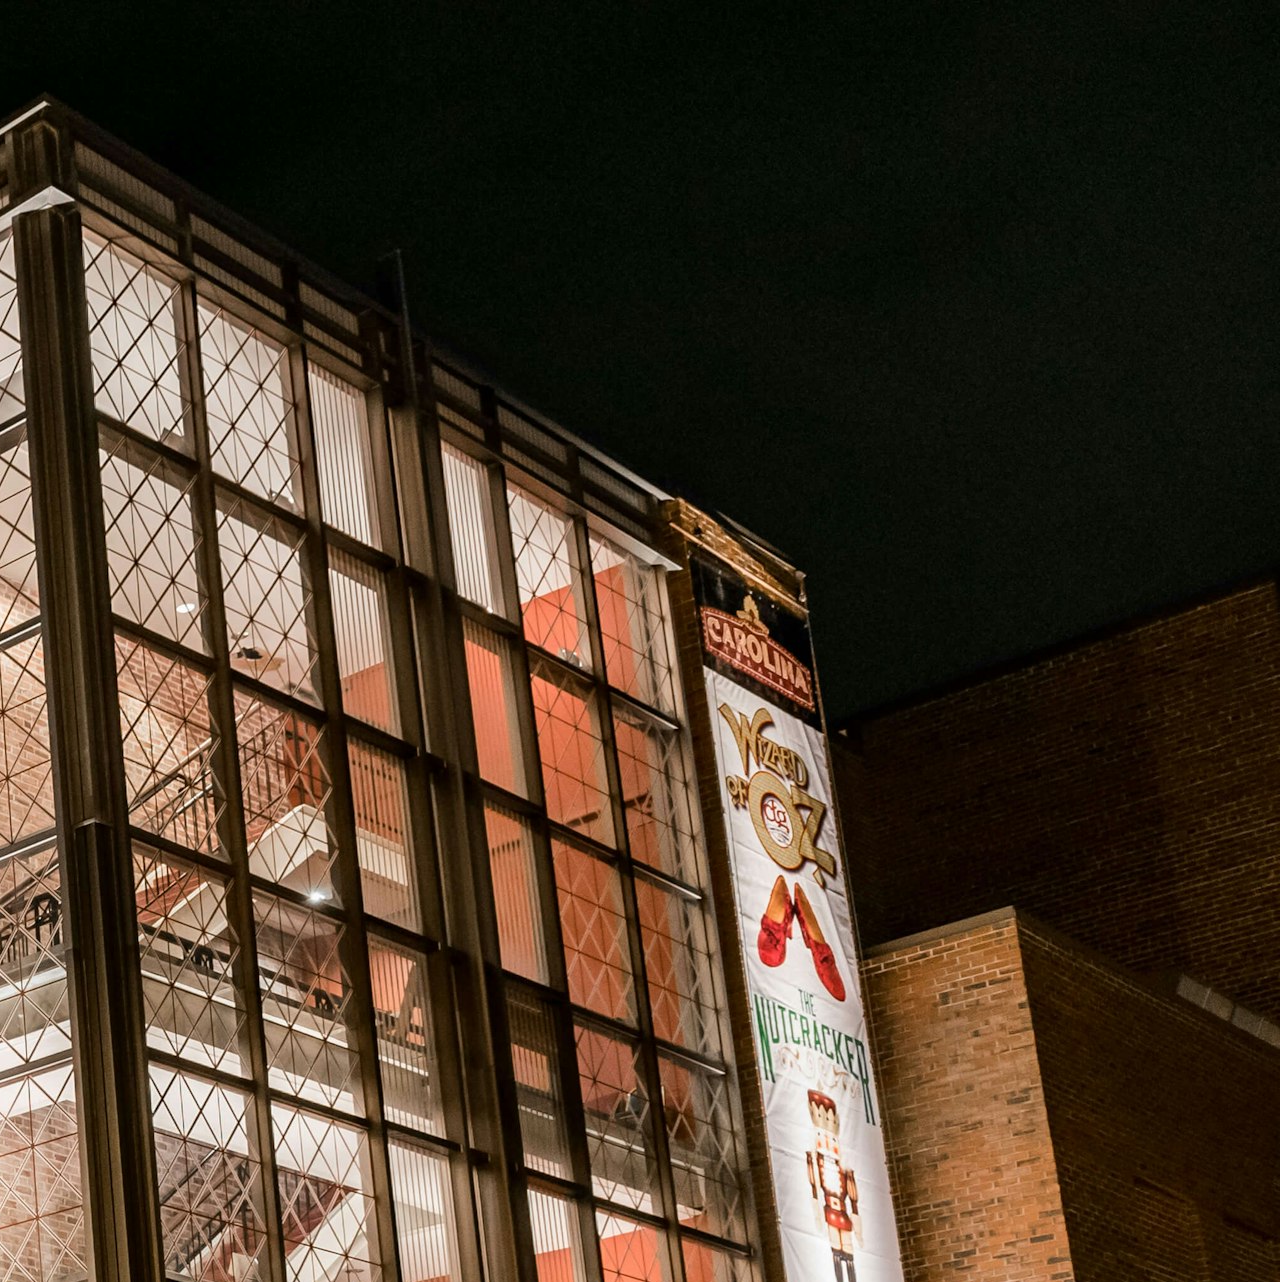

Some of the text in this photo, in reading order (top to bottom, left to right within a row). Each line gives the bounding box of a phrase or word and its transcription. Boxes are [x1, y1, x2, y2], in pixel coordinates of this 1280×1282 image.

[706, 616, 809, 695] CAROLINA
[748, 770, 837, 880] OZ
[798, 989, 817, 1017] THE
[754, 994, 876, 1126] NUTCRACKER
